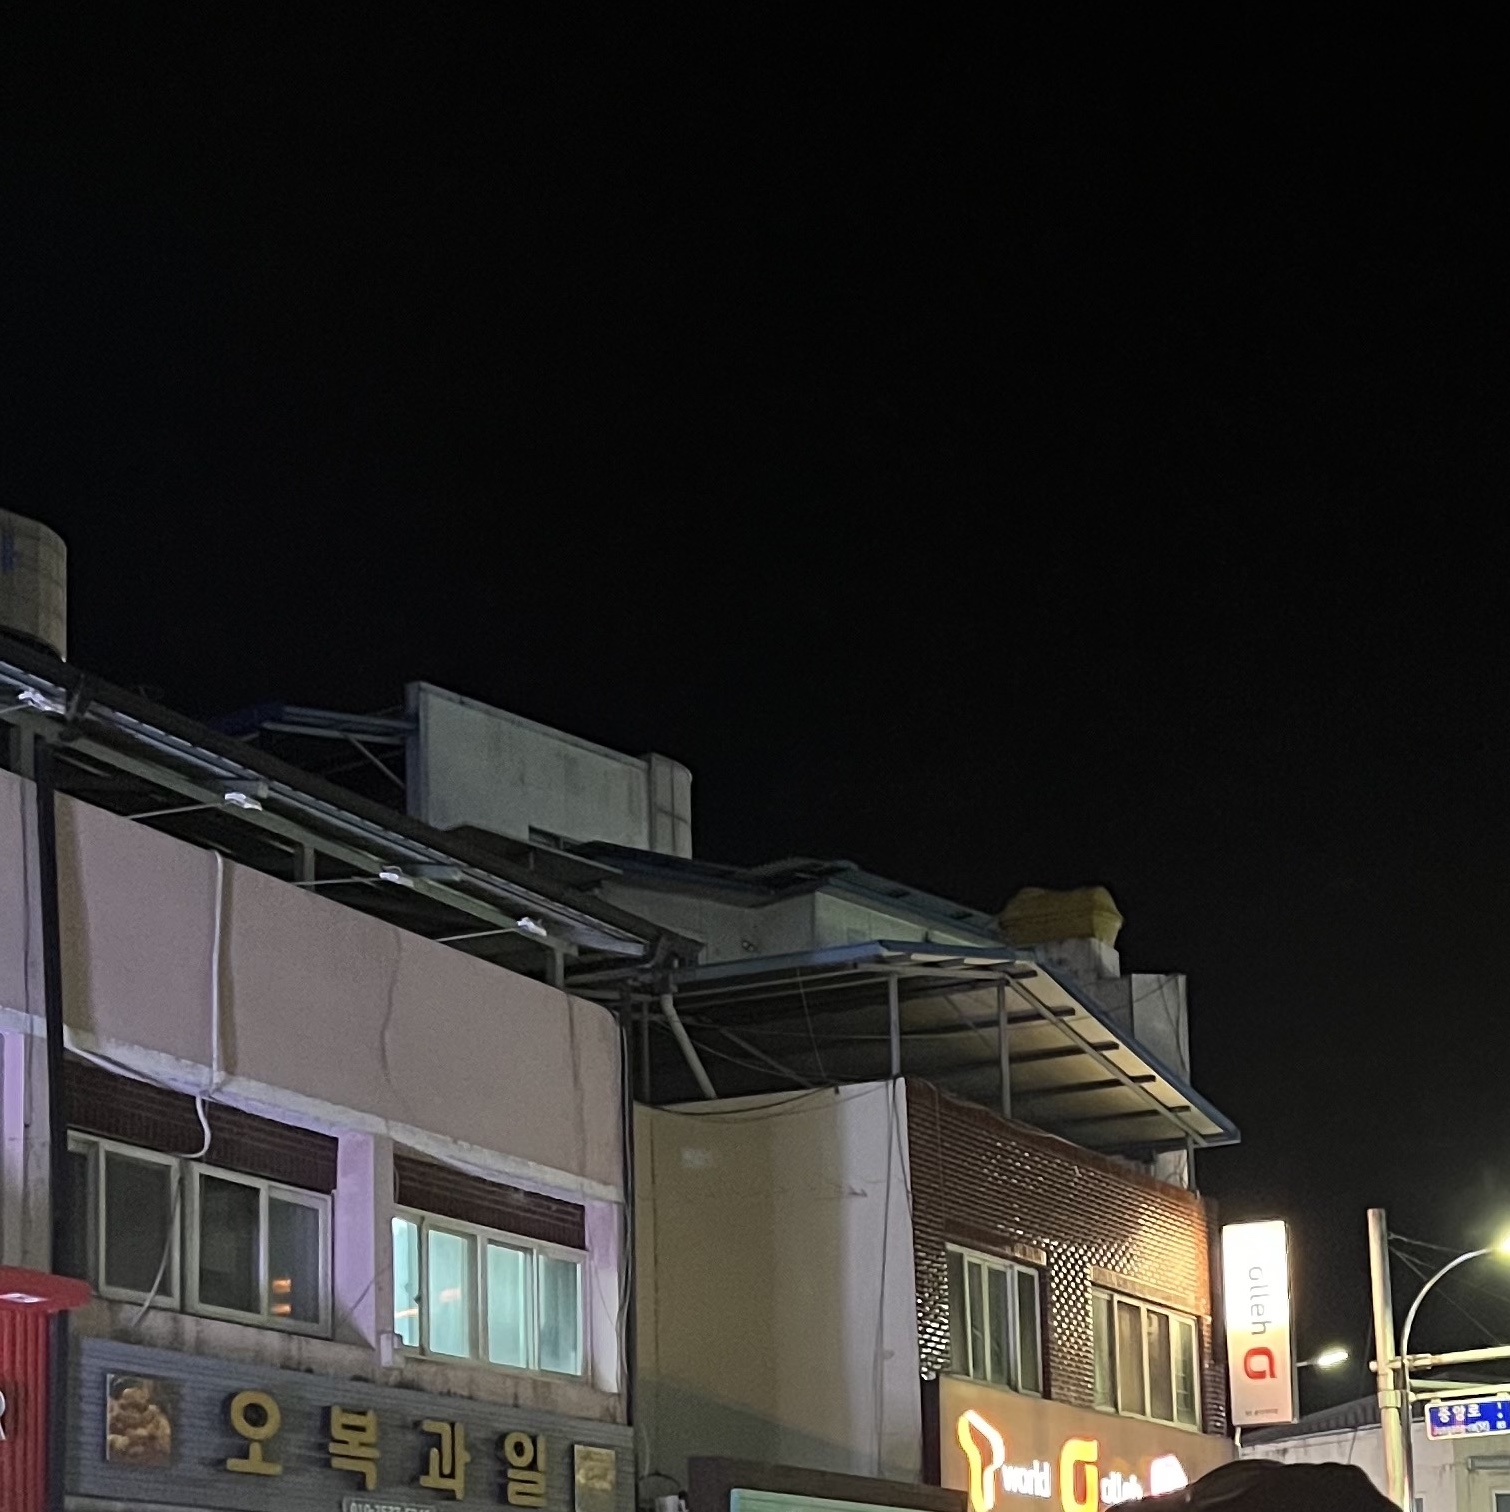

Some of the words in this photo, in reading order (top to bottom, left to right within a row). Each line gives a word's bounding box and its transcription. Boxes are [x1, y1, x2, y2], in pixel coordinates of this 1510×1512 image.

[1248, 1266, 1272, 1336] olleh
[1437, 1404, 1482, 1422] 중앙로
[226, 1390, 549, 1508] 오복과일
[1002, 1459, 1052, 1498] world
